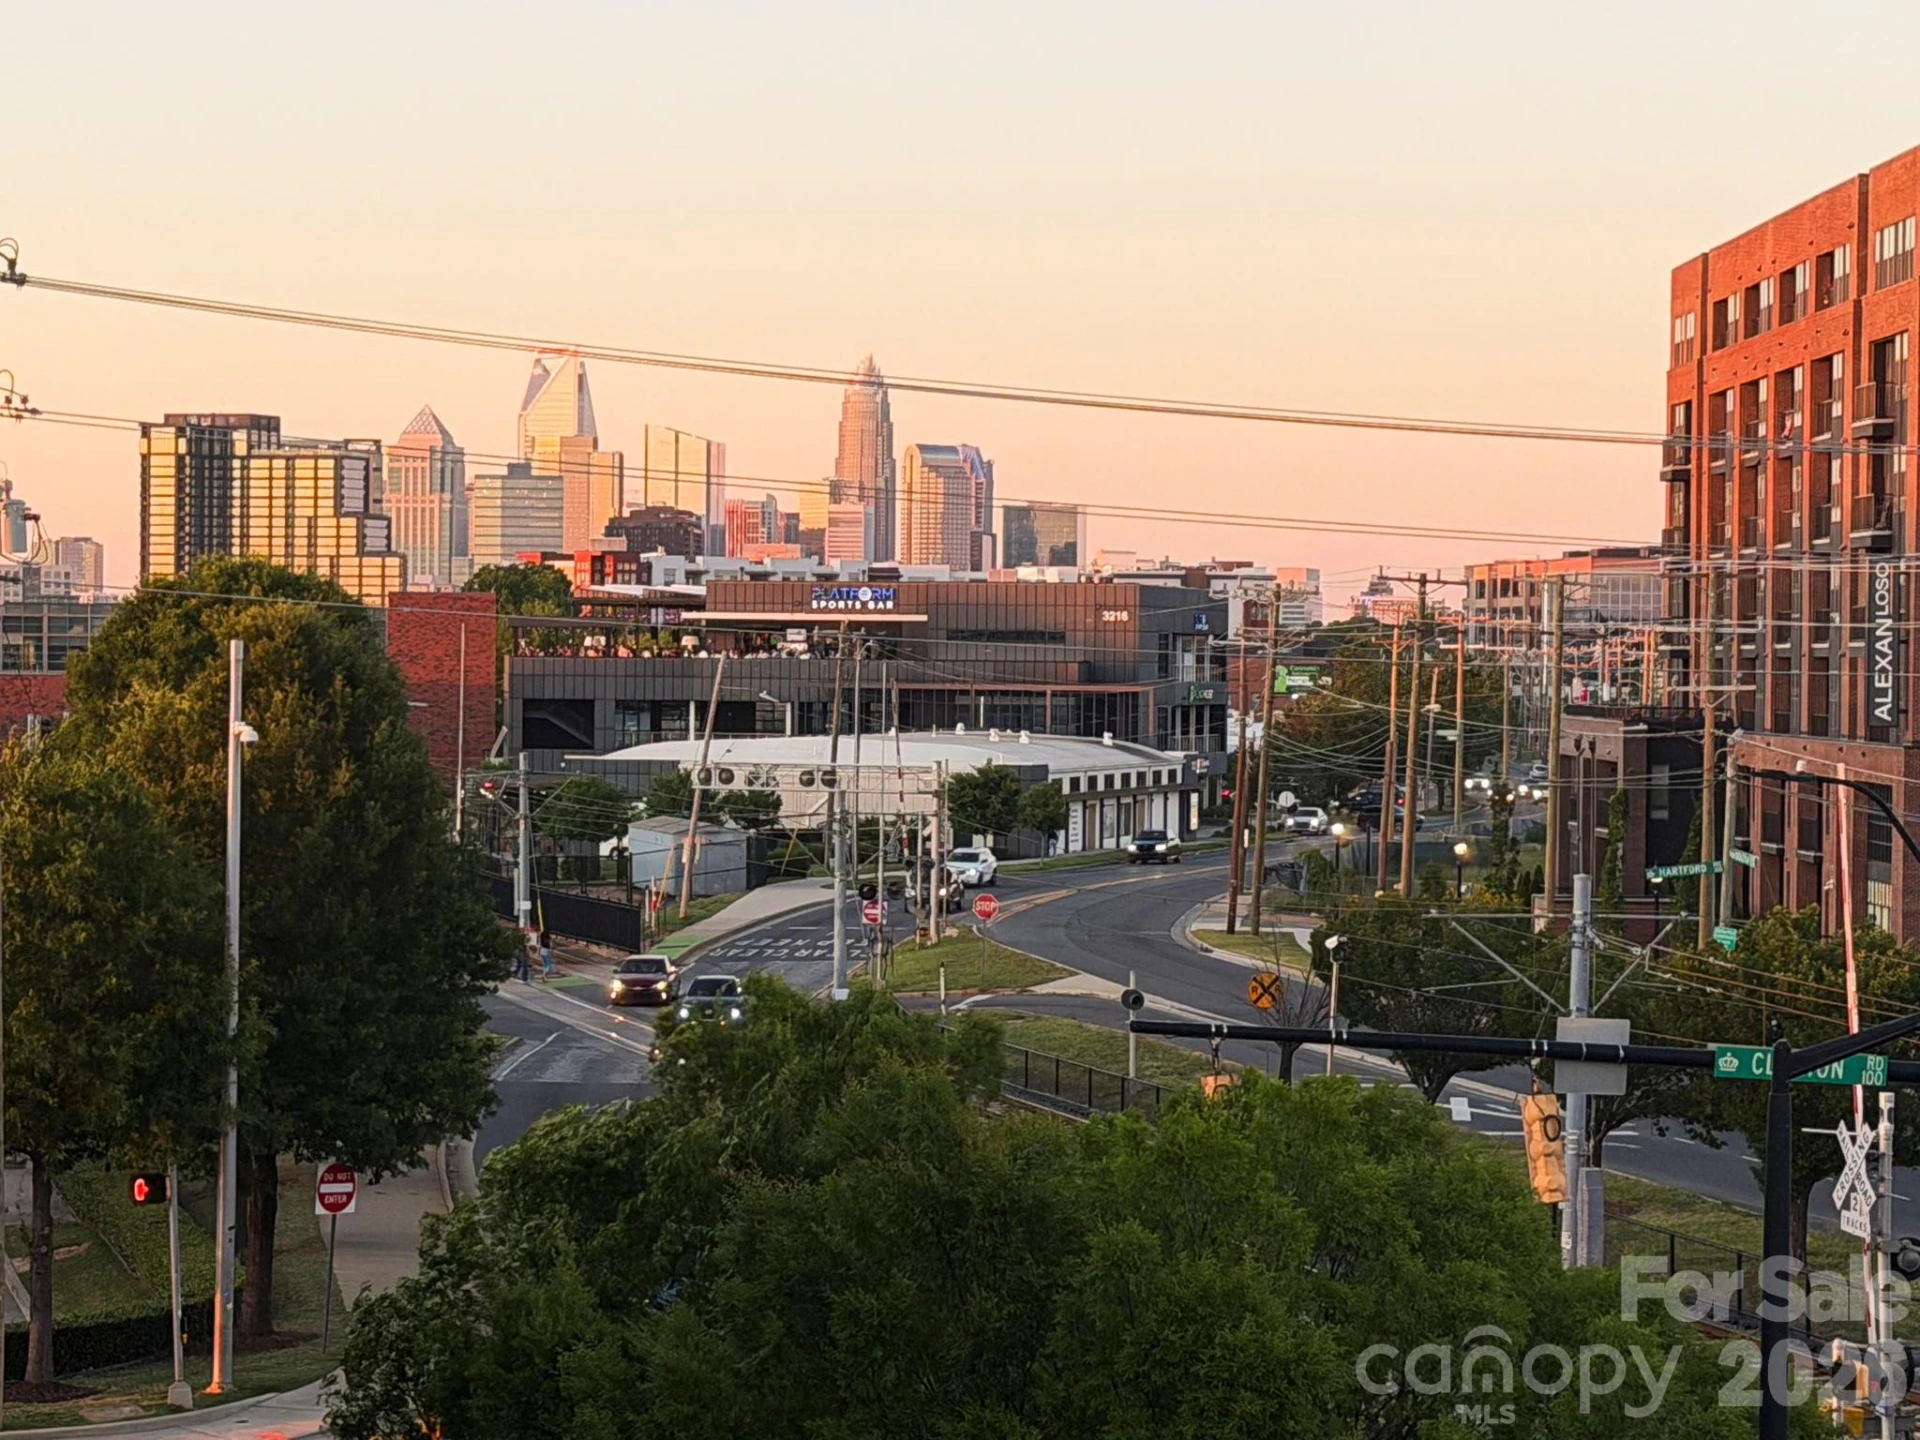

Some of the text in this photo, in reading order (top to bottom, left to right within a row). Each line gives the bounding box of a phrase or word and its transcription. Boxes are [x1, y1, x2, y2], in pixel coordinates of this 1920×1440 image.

[811, 587, 894, 601] PLATFORM
[811, 600, 894, 610] SPORTS BAR
[1874, 562, 1893, 722] ALEXAN LOSO
[1658, 864, 1708, 877] HARTFORD
[975, 900, 997, 911] STOP
[1751, 1052, 1844, 1079] CLON
[1866, 1056, 1884, 1071] RD
[1861, 1070, 1884, 1086] 100
[1835, 1131, 1870, 1201] CROSSING
[324, 1171, 352, 1182] DO NOT
[324, 1194, 347, 1204] ENTER
